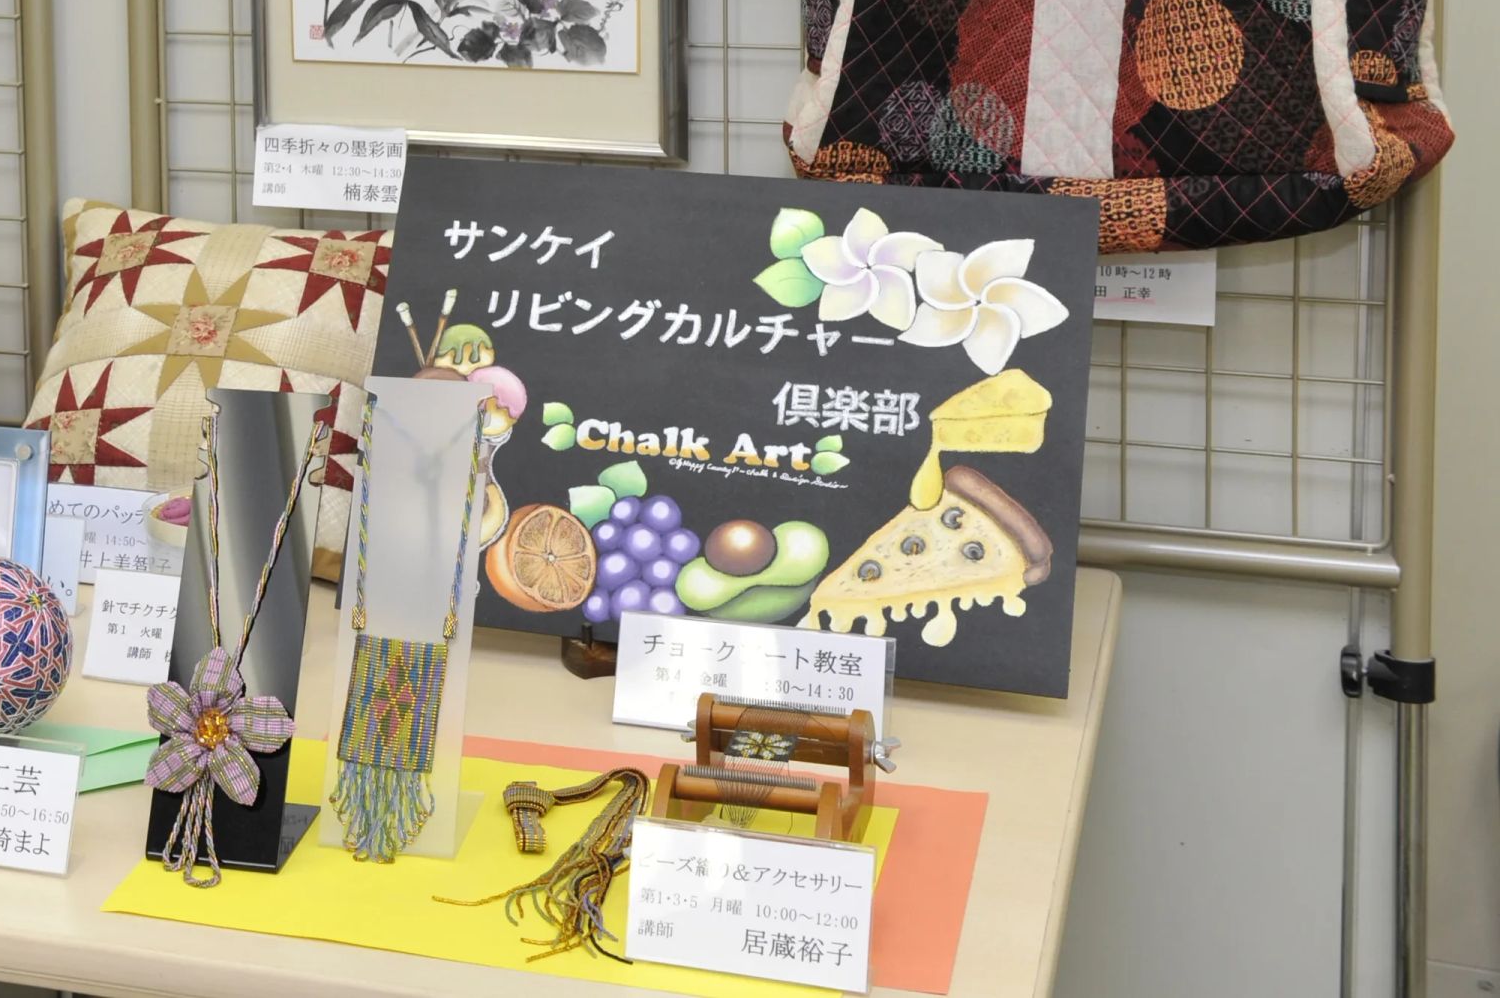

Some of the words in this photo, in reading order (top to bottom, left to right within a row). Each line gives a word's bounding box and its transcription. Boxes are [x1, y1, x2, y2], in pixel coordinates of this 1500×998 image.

[264, 137, 404, 159] 四季折々の墨彩画
[343, 183, 399, 203] 楠泰雲
[444, 220, 615, 269] サンケイ
[1123, 286, 1151, 299] 正幸
[487, 289, 895, 356] リビングカルチャー
[772, 381, 921, 436] 倶楽部
[576, 418, 711, 461] Chalk
[723, 432, 812, 471] Art
[140, 626, 162, 639] 火曜
[127, 646, 151, 660] 講師
[643, 633, 862, 677] チョークート教室
[710, 896, 743, 916] 月曜
[638, 919, 674, 939] 講師
[741, 928, 853, 967] 居蔵裕子
